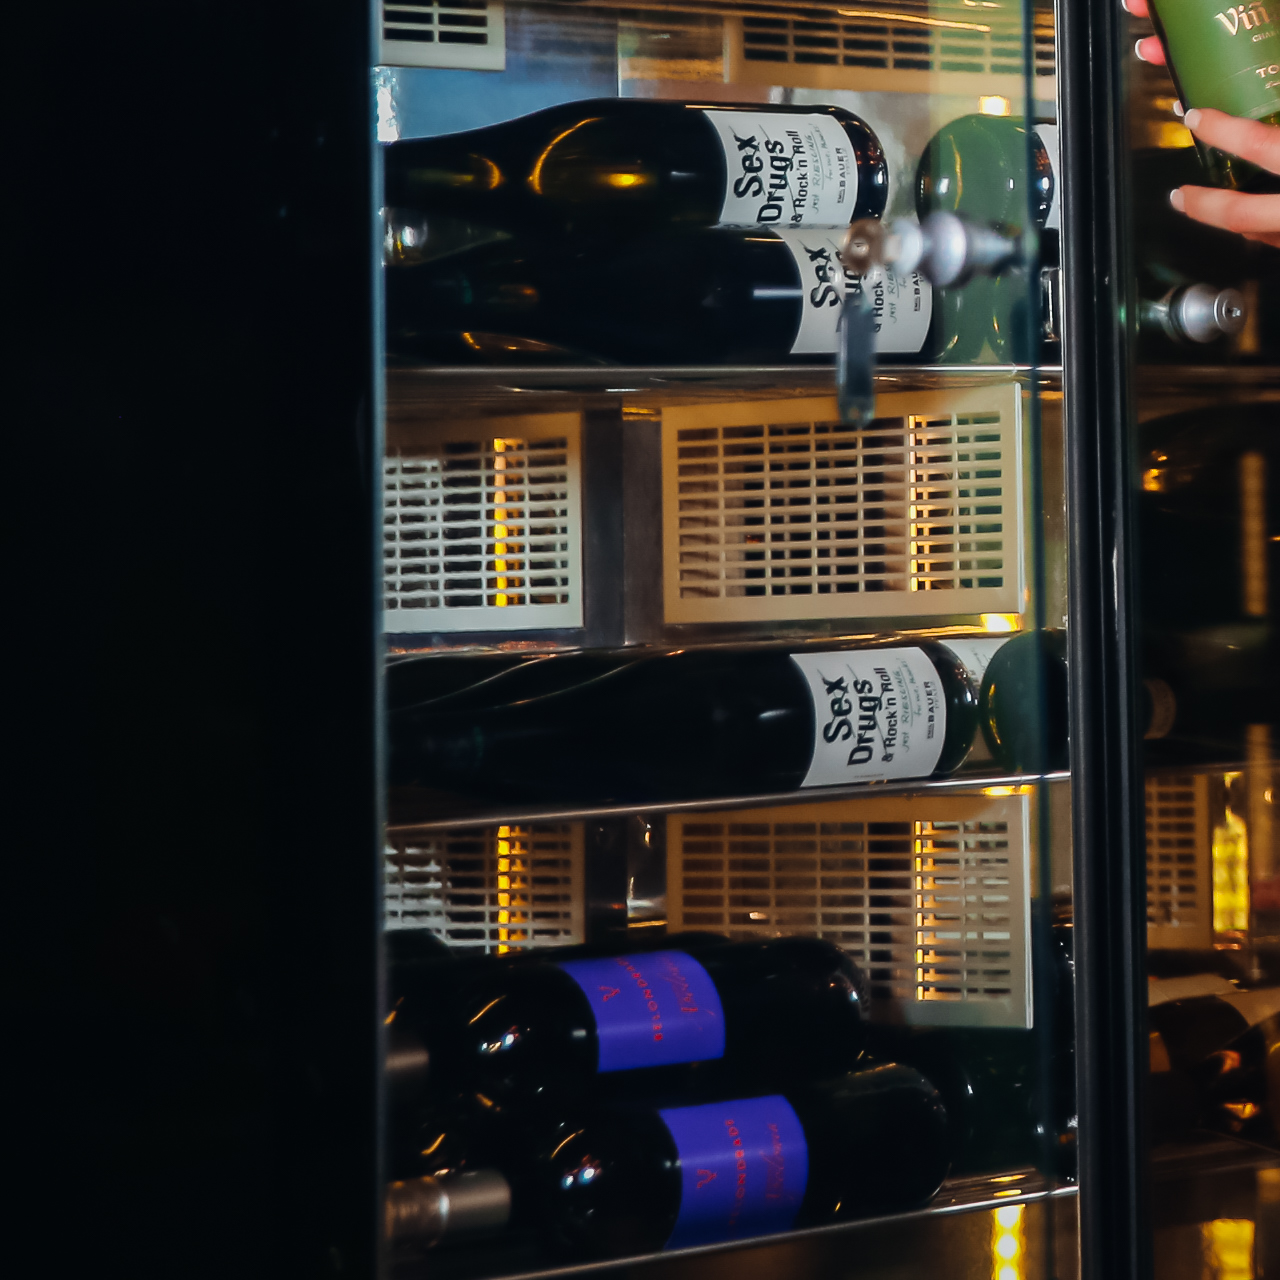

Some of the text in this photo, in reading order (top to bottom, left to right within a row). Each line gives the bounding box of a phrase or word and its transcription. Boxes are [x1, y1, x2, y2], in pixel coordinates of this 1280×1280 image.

[733, 133, 764, 199] Sex
[756, 139, 794, 223] Drugs
[786, 129, 810, 223] & Rock'n Roll
[804, 133, 821, 187] RIESLING
[834, 147, 847, 189] BAUER
[804, 247, 840, 308] Sex
[911, 272, 921, 296] BAU
[821, 675, 853, 744] Sex
[847, 679, 884, 767] Drugs
[873, 667, 898, 763] & Rock'n Roll
[892, 670, 911, 725] RIESLING
[923, 681, 936, 723] BAUER
